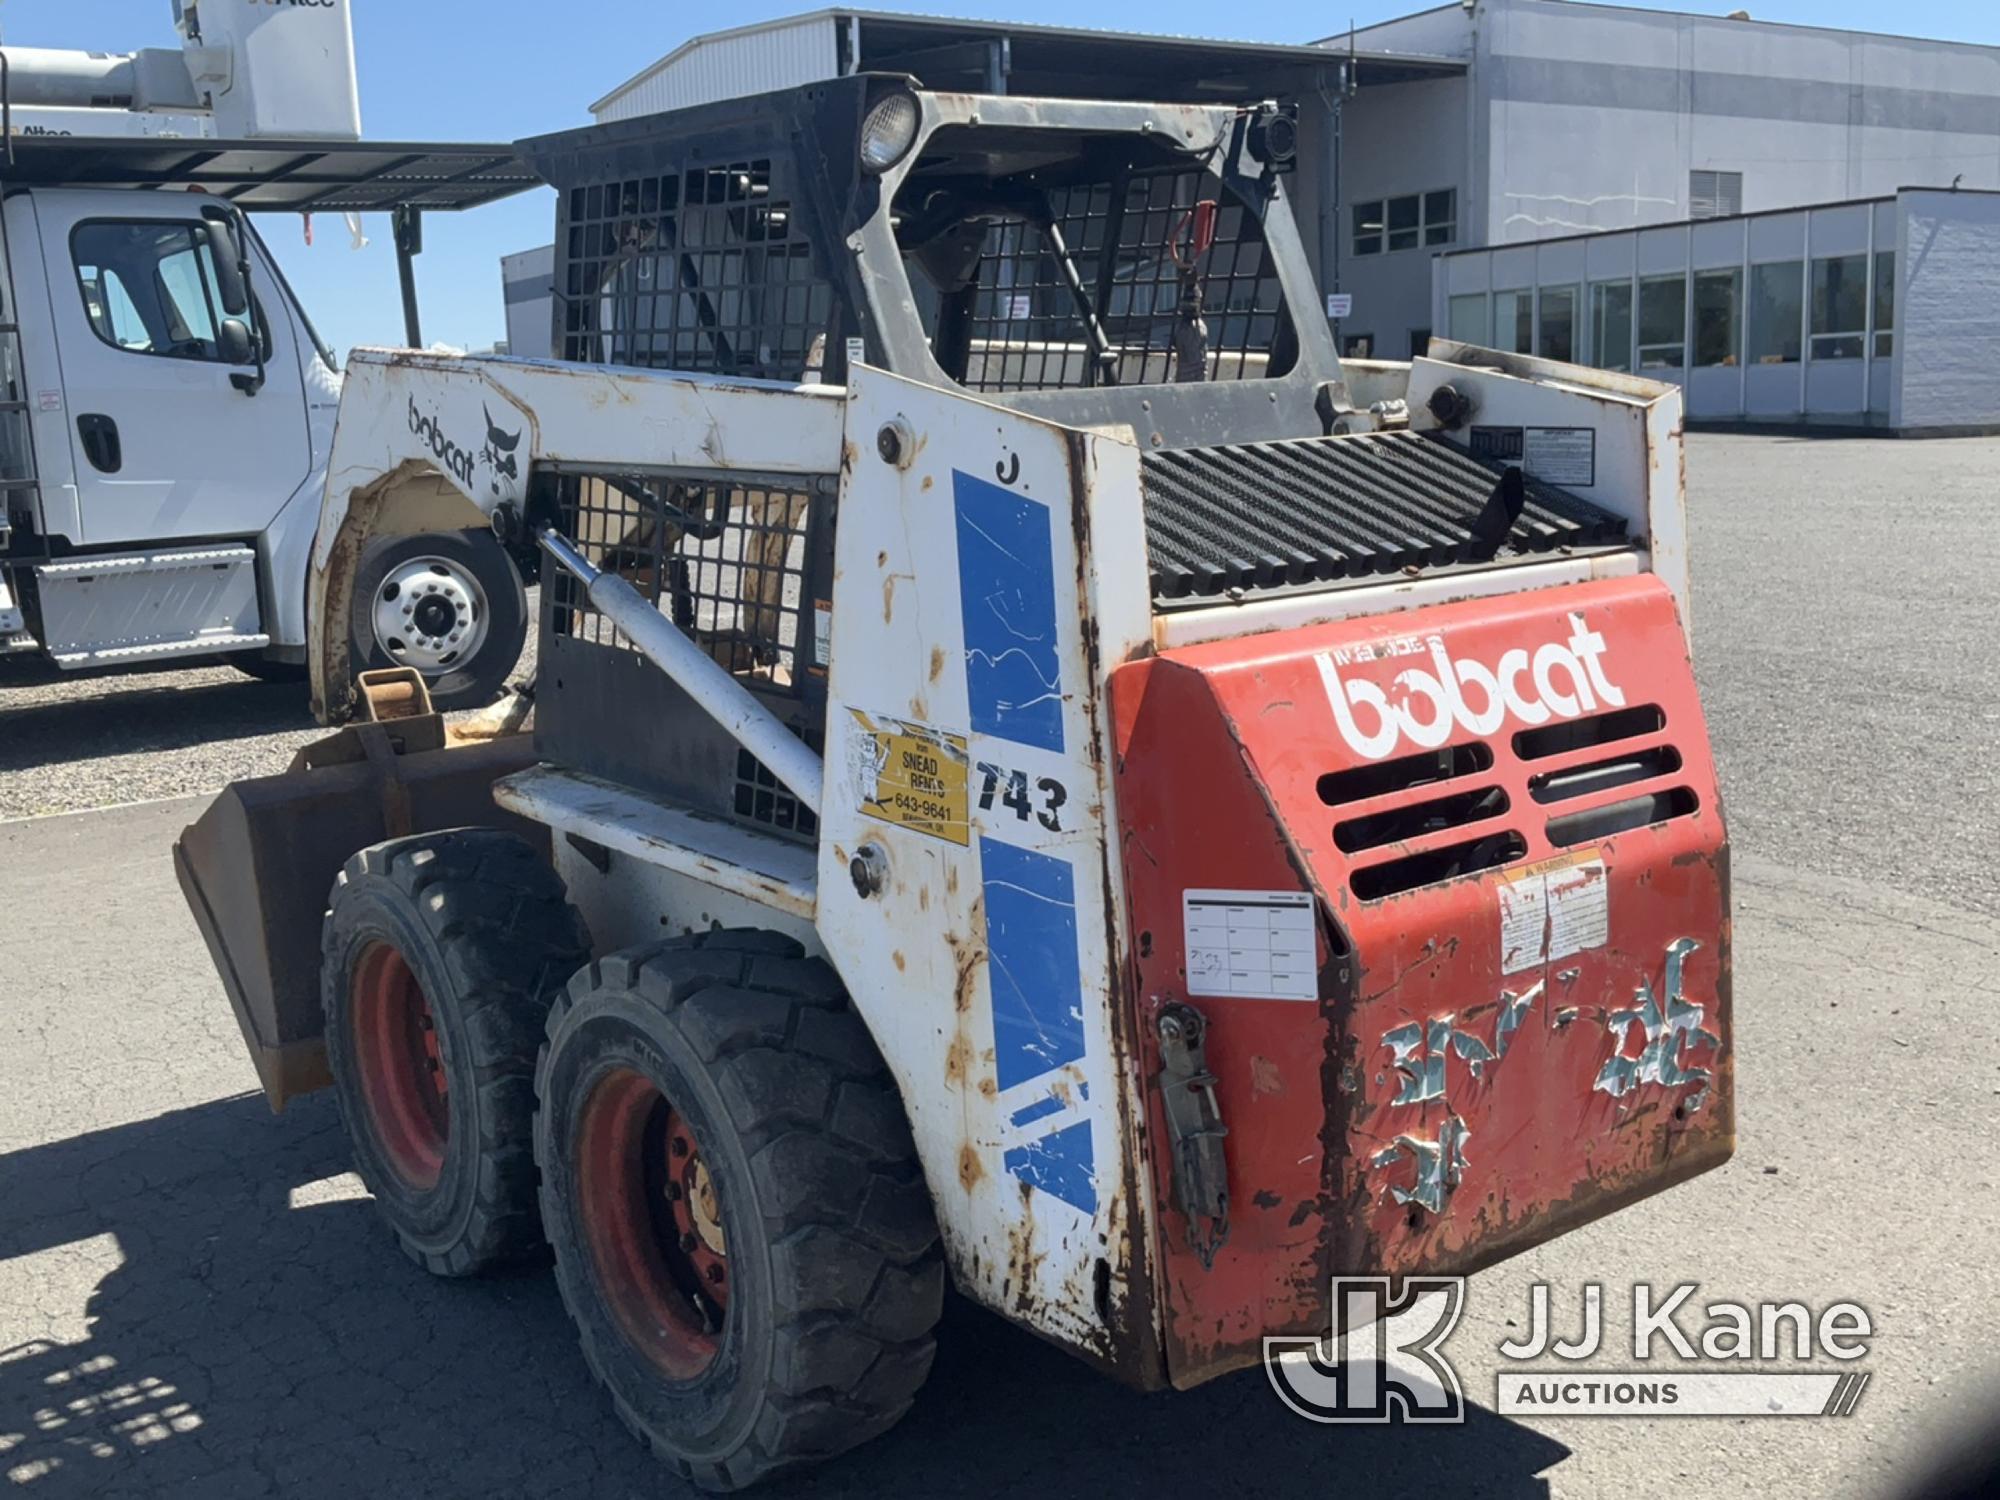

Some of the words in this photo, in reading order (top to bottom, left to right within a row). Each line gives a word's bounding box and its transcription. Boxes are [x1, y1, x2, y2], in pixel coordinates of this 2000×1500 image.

[408, 391, 474, 490] bobcat
[1313, 612, 1626, 759] bobcat
[902, 751, 938, 776] SNEAD
[911, 771, 945, 799] RENTS
[895, 793, 951, 821] 643-9641
[976, 761, 1068, 832] 743
